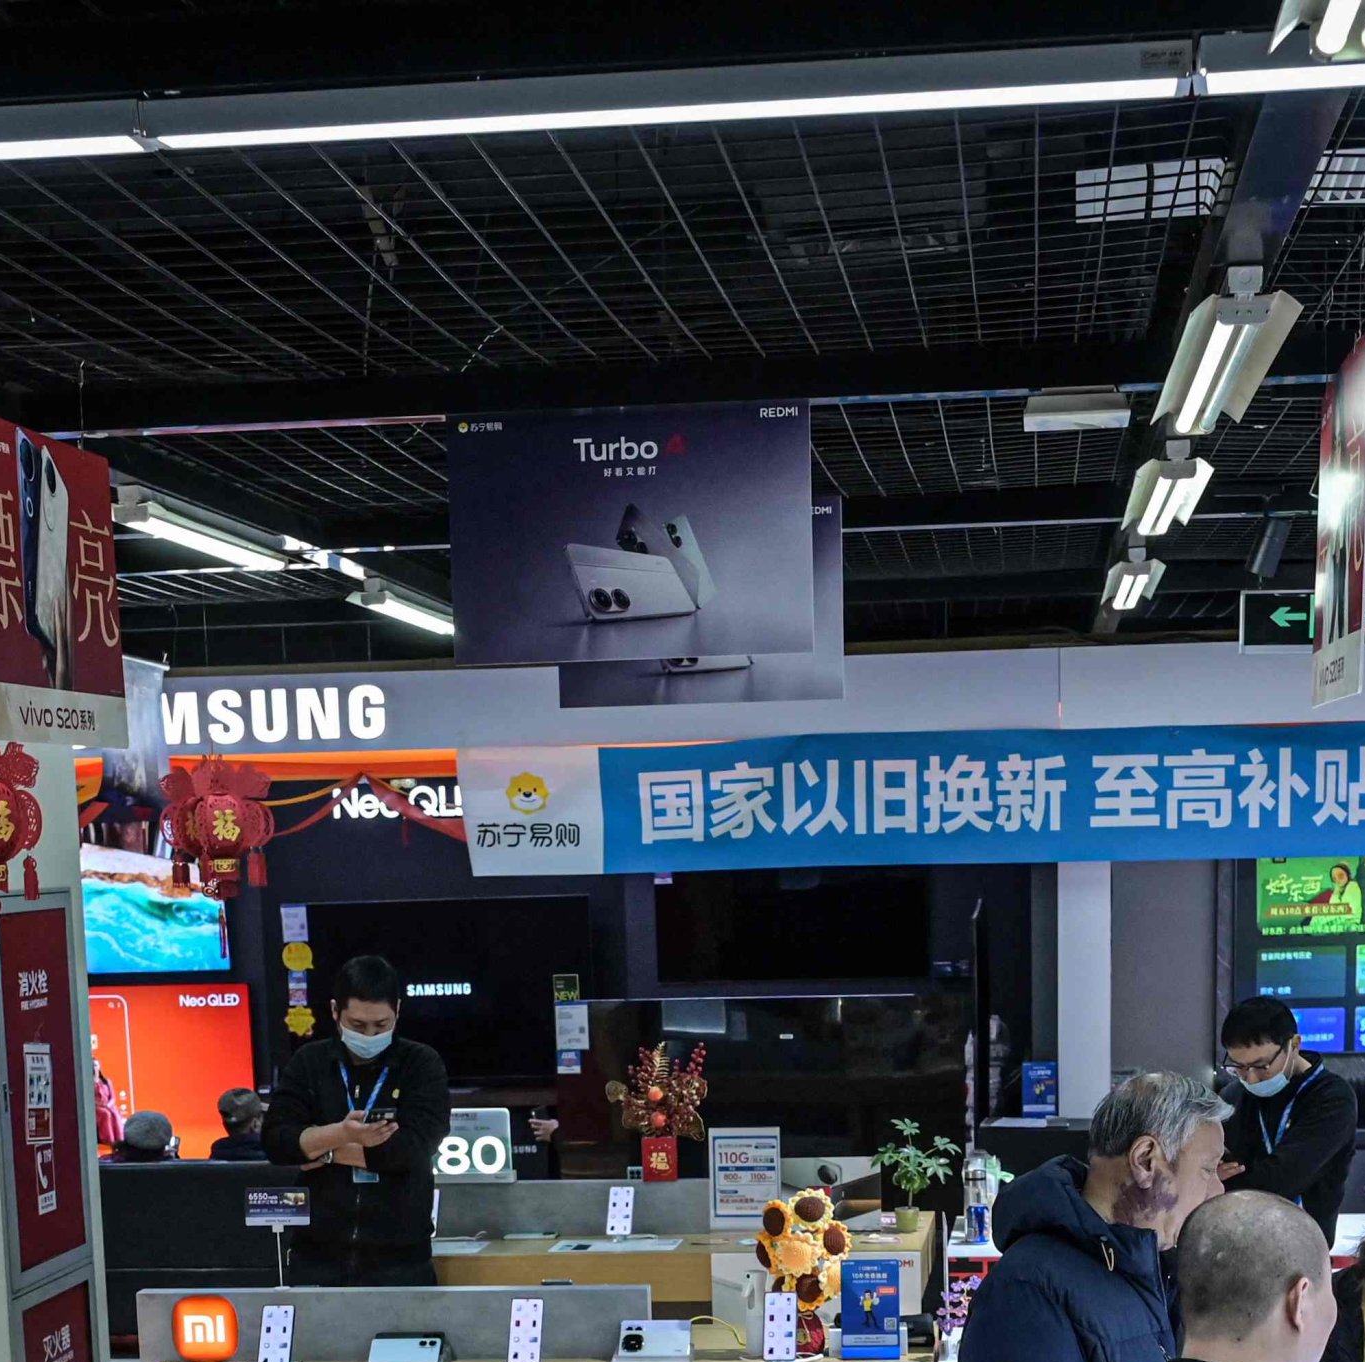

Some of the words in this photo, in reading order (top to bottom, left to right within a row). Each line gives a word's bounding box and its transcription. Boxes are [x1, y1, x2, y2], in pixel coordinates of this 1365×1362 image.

[759, 406, 799, 419] REDMI
[573, 437, 659, 463] Turbo
[603, 465, 658, 478] 好看又能打
[68, 508, 120, 649] 亮
[19, 699, 54, 730] vivo
[55, 705, 96, 731] S20系列
[162, 684, 387, 745] MSUNG
[637, 752, 1068, 845] 国家以旧换新
[211, 809, 247, 842] 福
[476, 822, 582, 849] 苏宁易购
[18, 968, 48, 997] 消火栓
[406, 983, 472, 996] SAMSUNG
[179, 994, 207, 1008] Neo
[207, 993, 240, 1007] QLED
[718, 1151, 750, 1165] 110G
[42, 1324, 71, 1362] 灭火器
